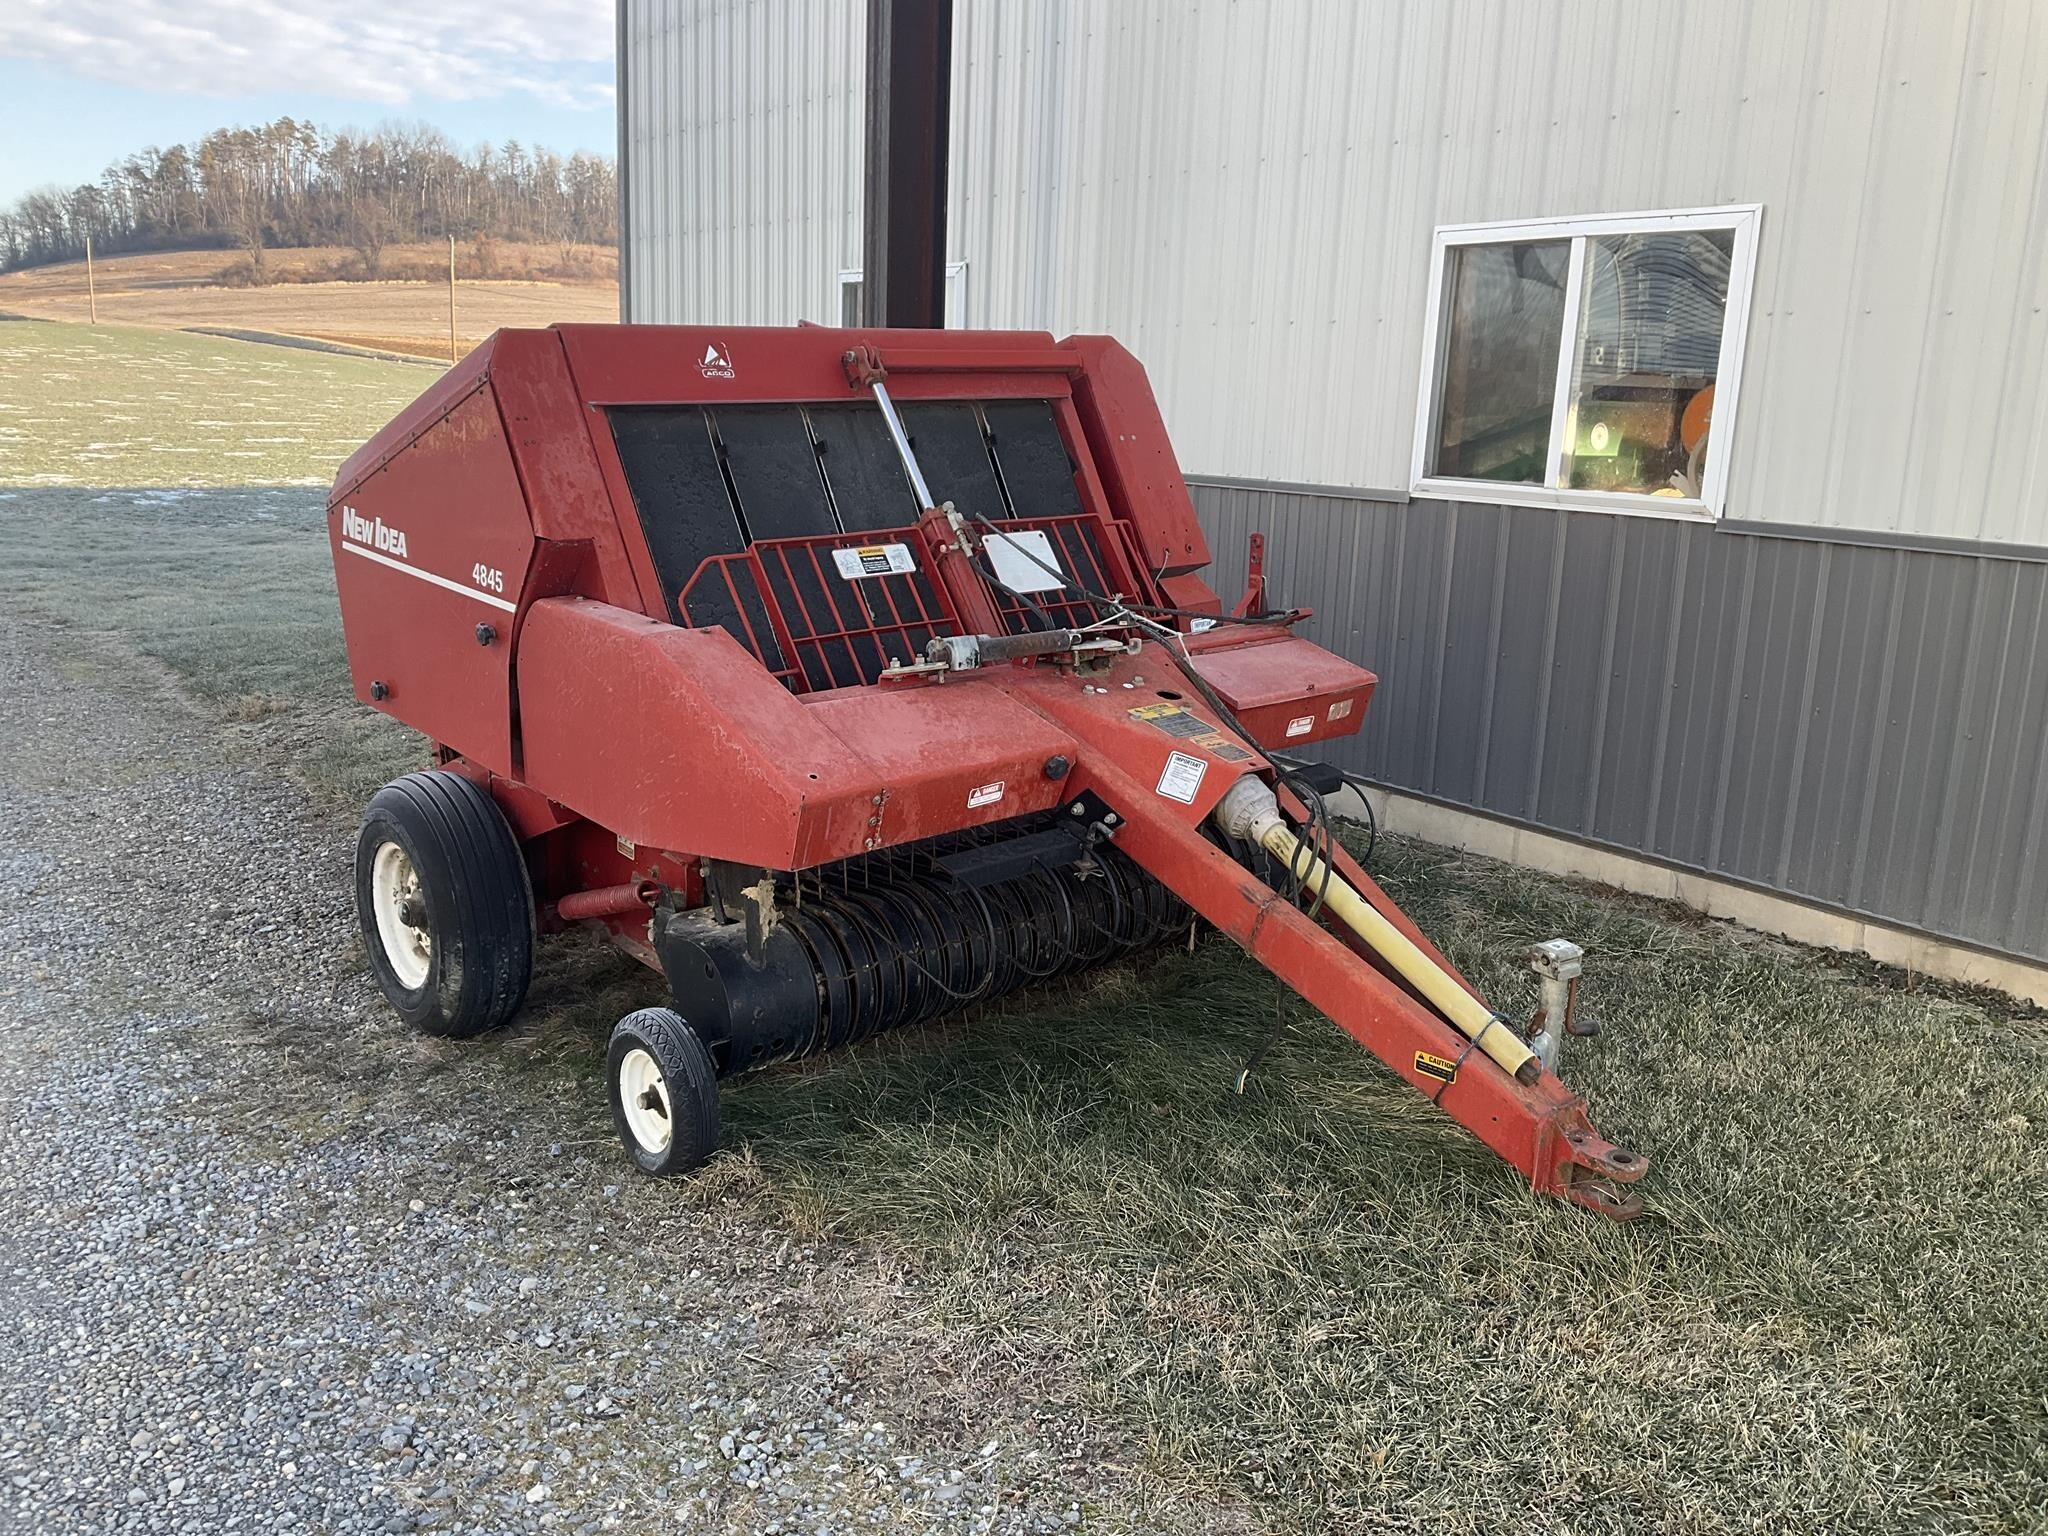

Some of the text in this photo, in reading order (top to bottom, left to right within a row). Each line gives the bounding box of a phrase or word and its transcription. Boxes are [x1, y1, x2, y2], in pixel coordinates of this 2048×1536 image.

[472, 562, 503, 593] 4845
[1174, 755, 1202, 769] IMPORTANT
[1428, 1055, 1456, 1070] CAUTION
